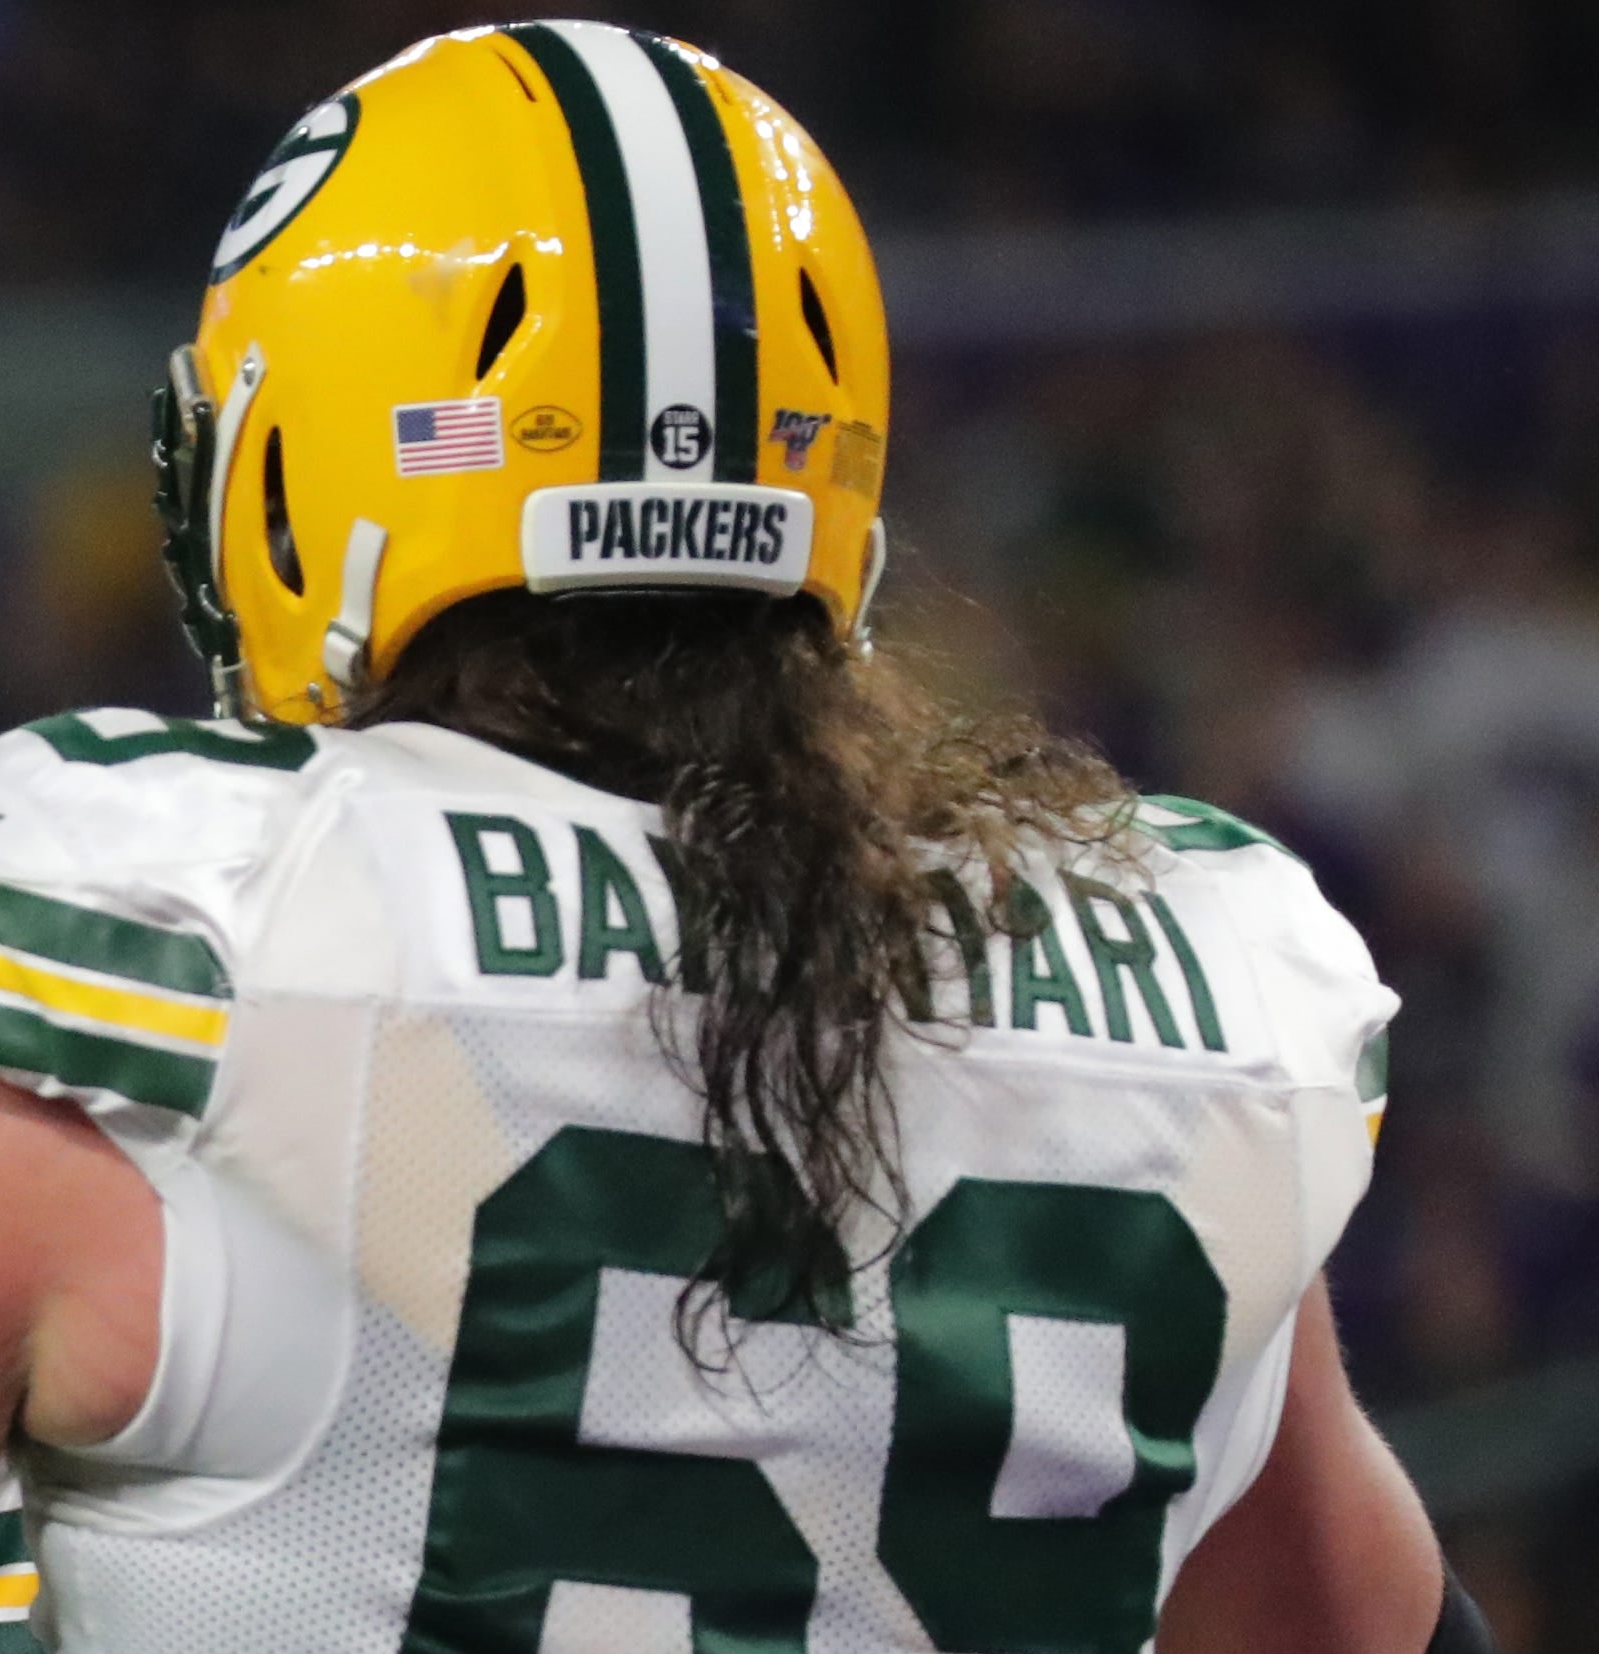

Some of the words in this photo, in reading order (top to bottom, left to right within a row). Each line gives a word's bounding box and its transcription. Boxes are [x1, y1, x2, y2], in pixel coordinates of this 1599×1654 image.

[663, 426, 699, 462] 15
[568, 498, 788, 564] PACKERS
[443, 811, 1228, 1053] BAIARI
